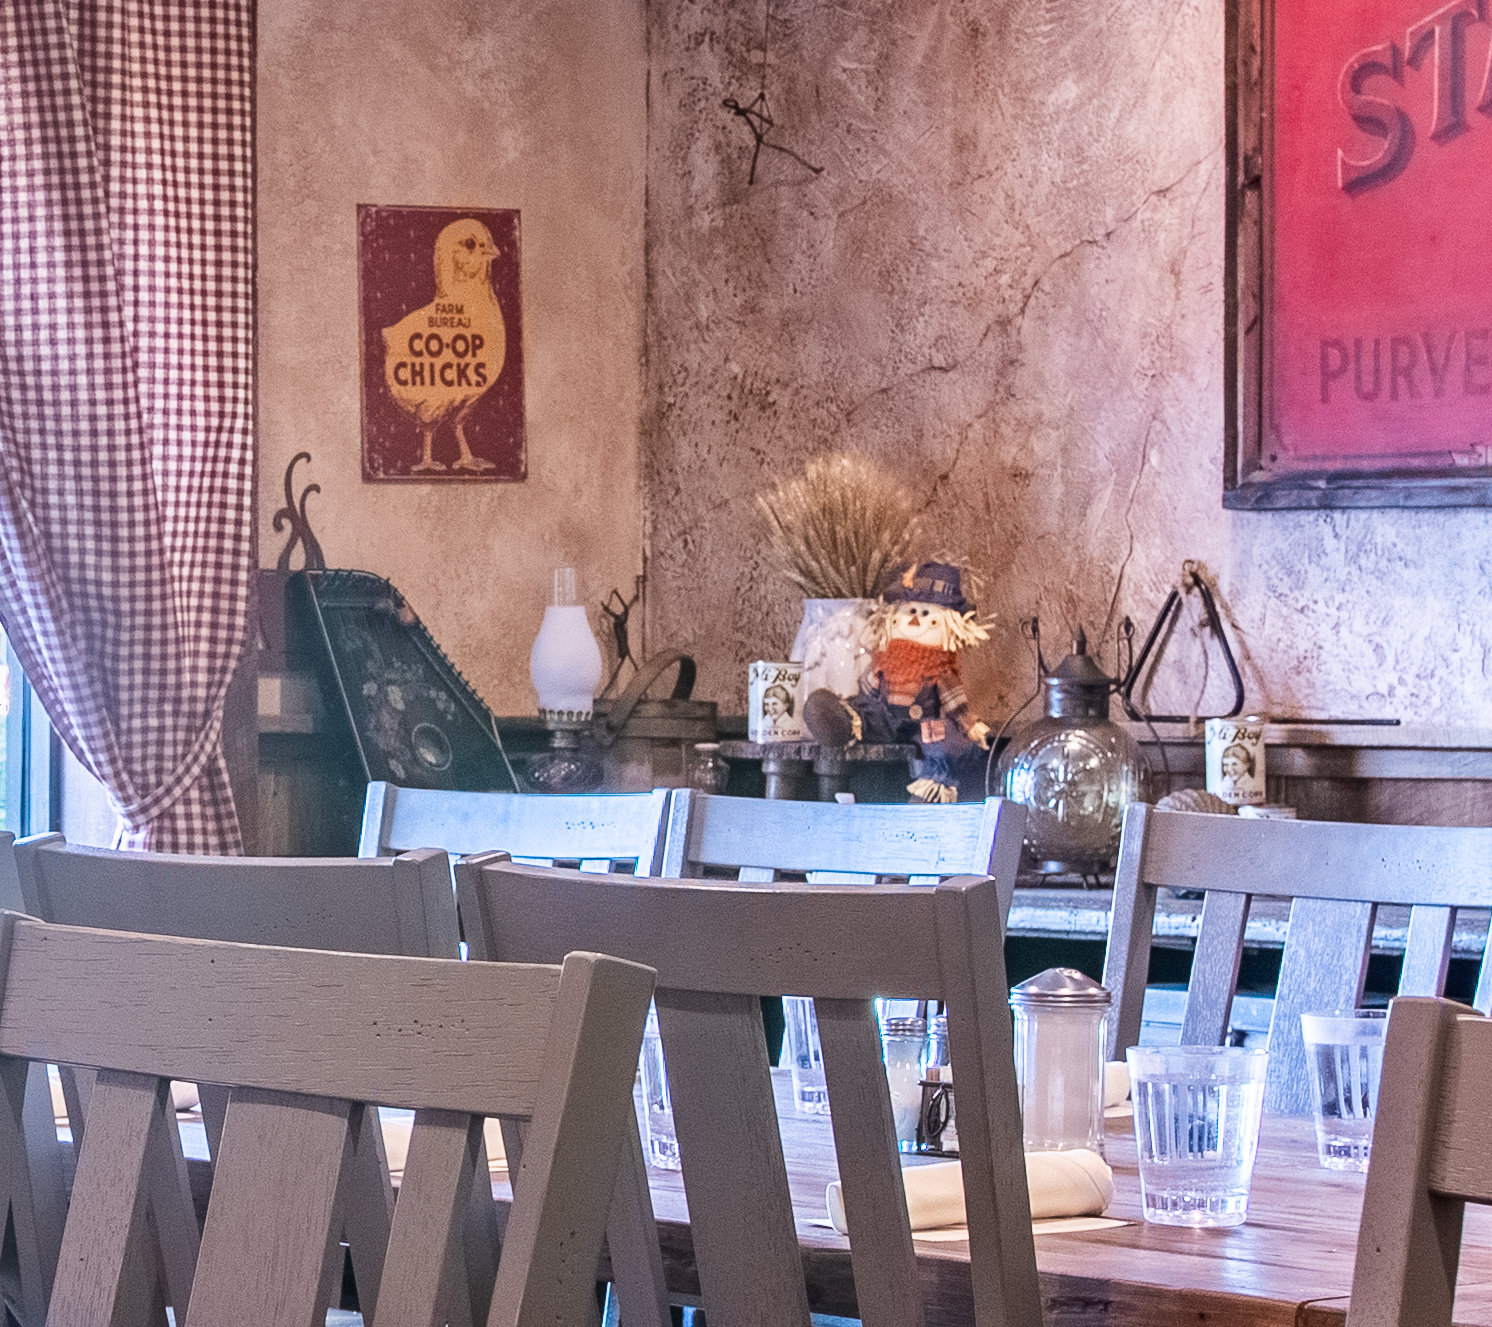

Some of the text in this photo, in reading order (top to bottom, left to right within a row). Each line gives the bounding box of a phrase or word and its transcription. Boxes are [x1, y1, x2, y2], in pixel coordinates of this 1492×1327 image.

[435, 303, 465, 315] FARM
[427, 316, 472, 329] BUREAU
[393, 360, 488, 388] CHICKS
